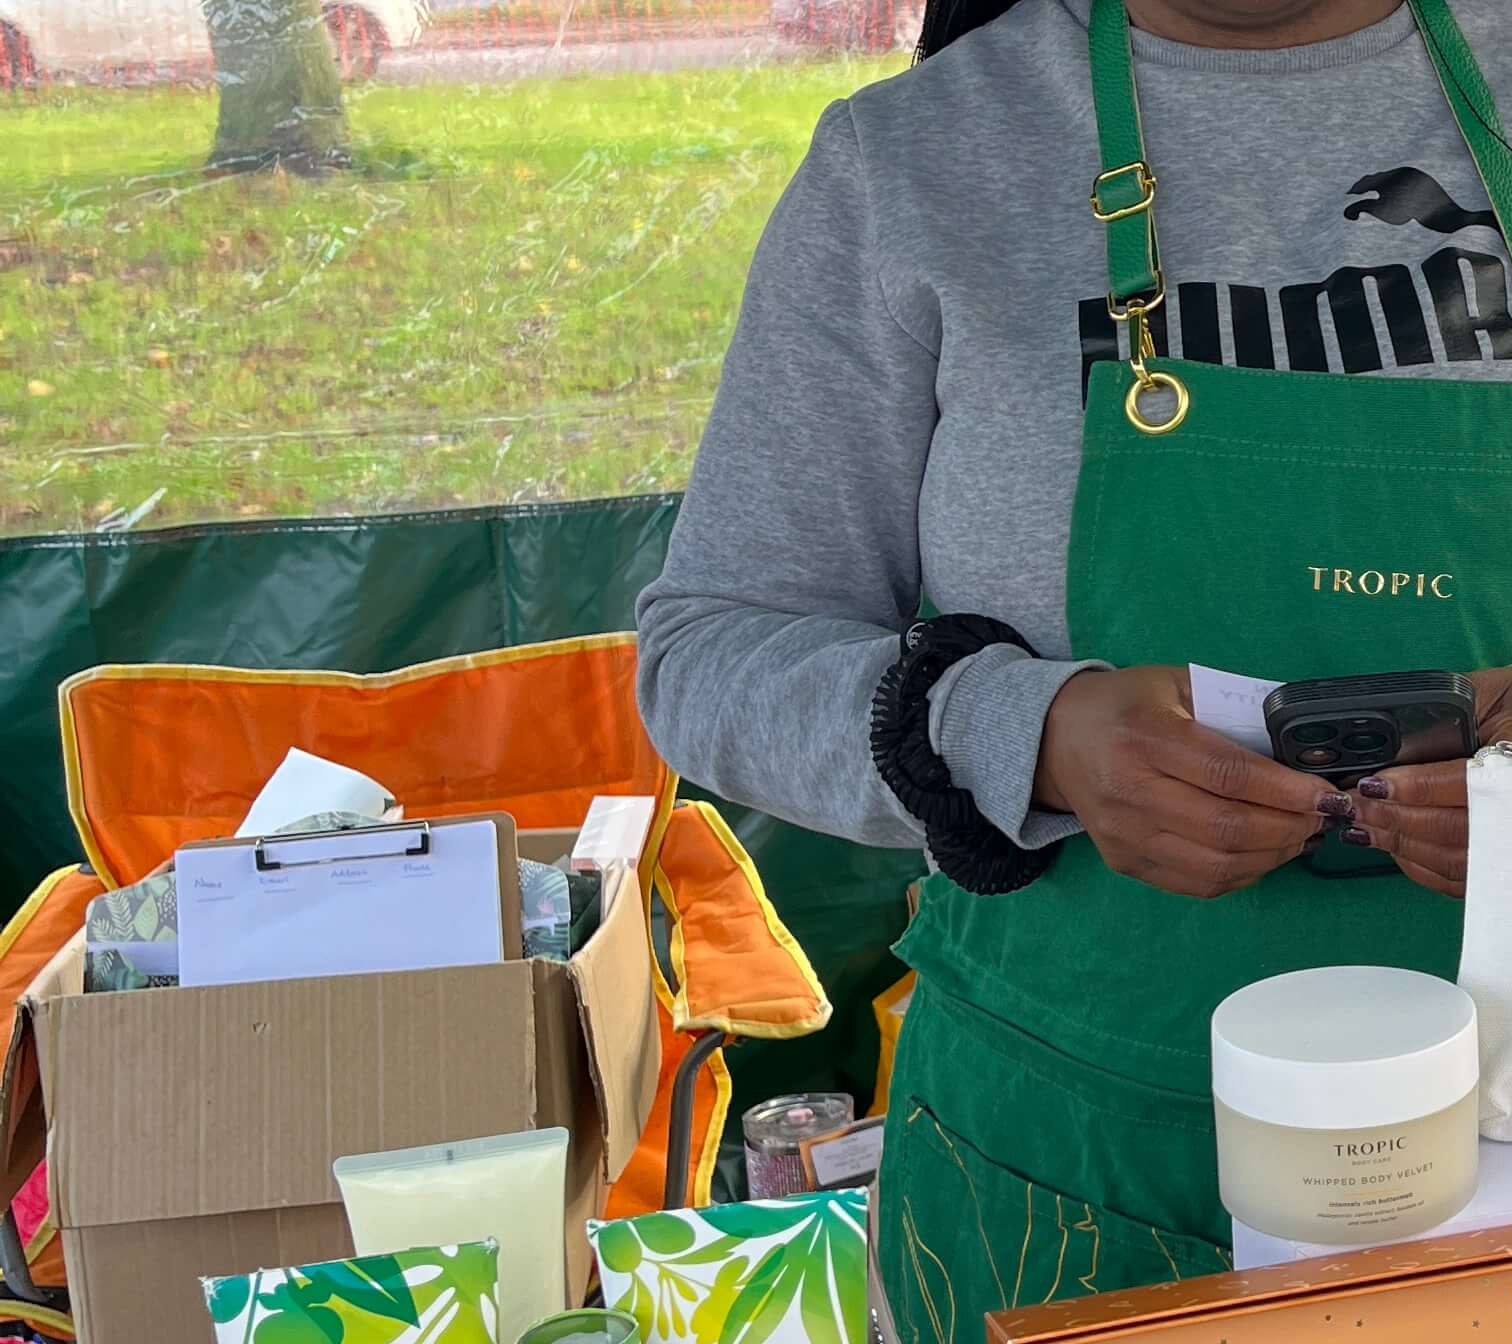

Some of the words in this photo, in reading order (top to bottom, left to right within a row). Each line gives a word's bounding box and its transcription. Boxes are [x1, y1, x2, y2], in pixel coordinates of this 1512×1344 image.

[1308, 566, 1454, 599] TROPIC
[1333, 1136, 1408, 1157] TROPIC
[1303, 1176, 1356, 1187] WHIPPED
[1361, 1172, 1393, 1185] BODY
[1397, 1161, 1434, 1180] VELVET
